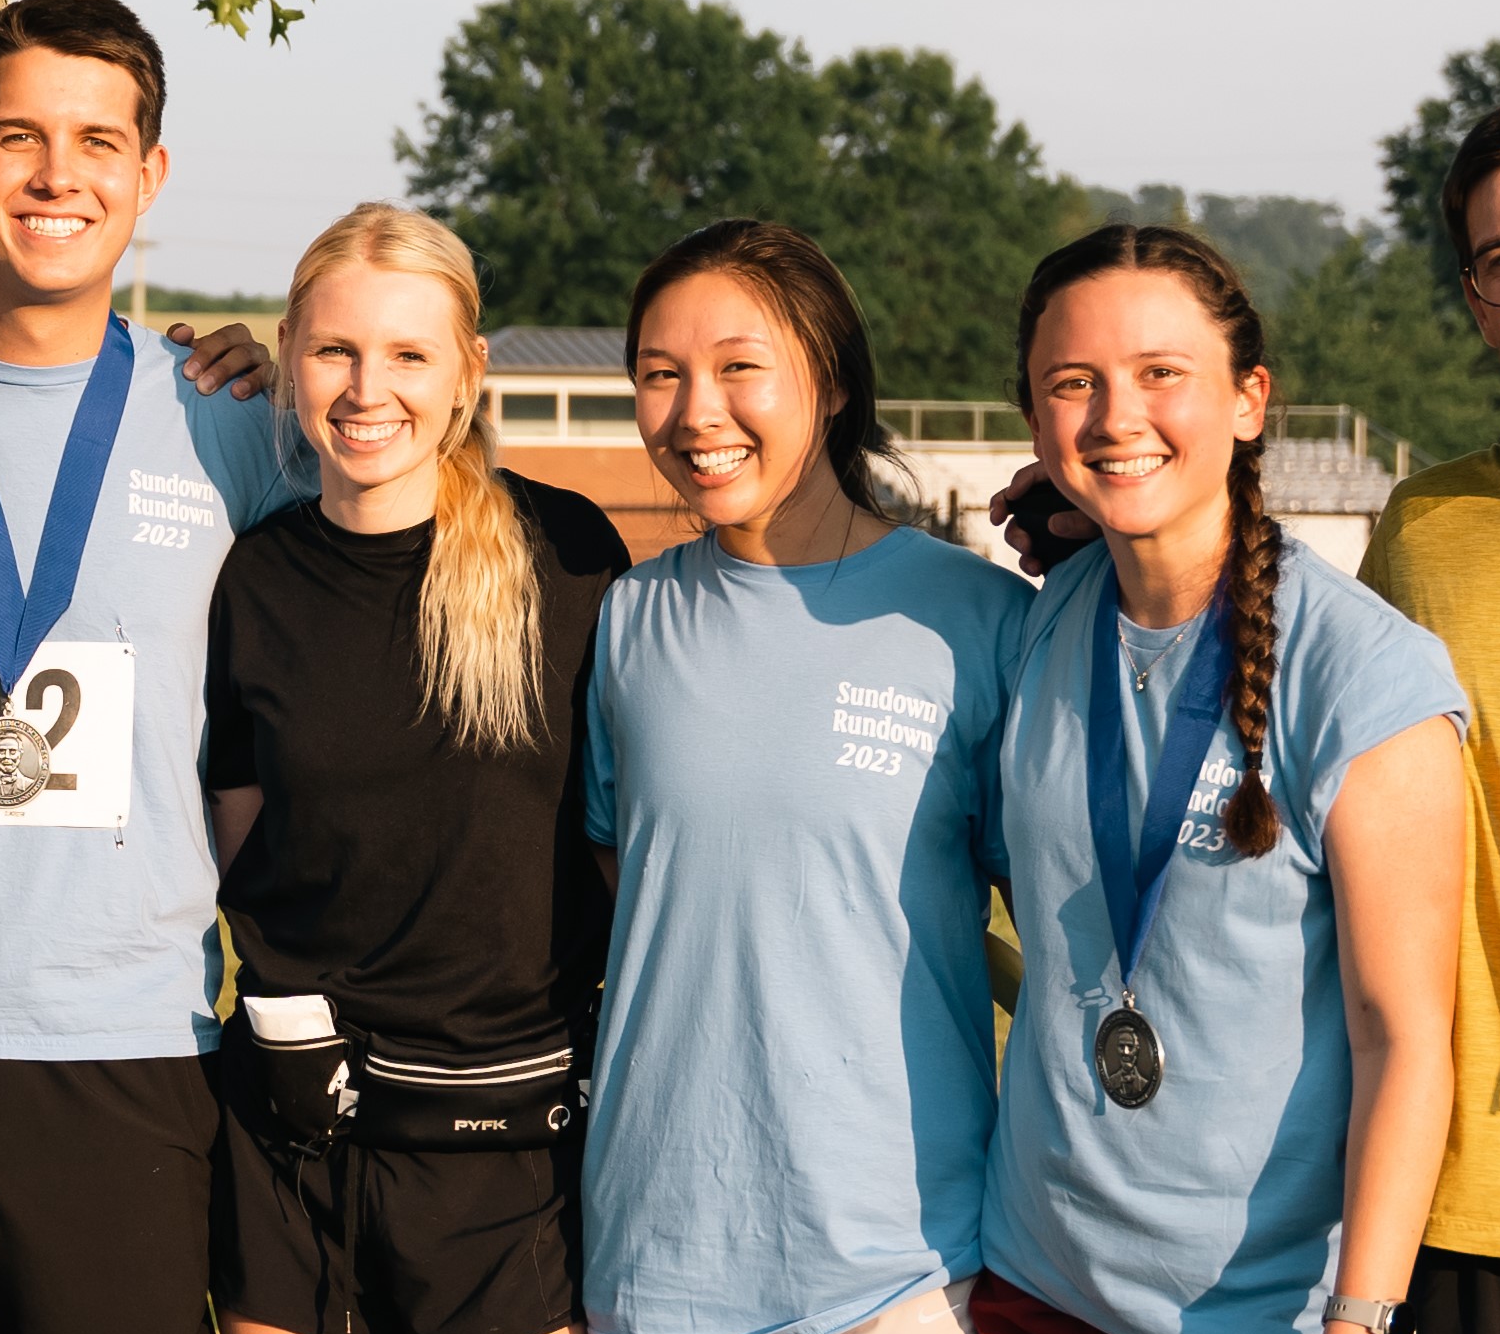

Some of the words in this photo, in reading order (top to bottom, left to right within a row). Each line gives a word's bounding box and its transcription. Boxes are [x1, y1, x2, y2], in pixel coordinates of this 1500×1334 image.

[128, 468, 214, 503] Sundown
[127, 492, 215, 528] Rundown
[131, 521, 191, 550] 2023
[835, 681, 938, 724] Sundown
[832, 708, 934, 753] Rundown
[835, 742, 903, 776] 2023
[1177, 819, 1228, 852] 023
[454, 1119, 508, 1131] PYFK
